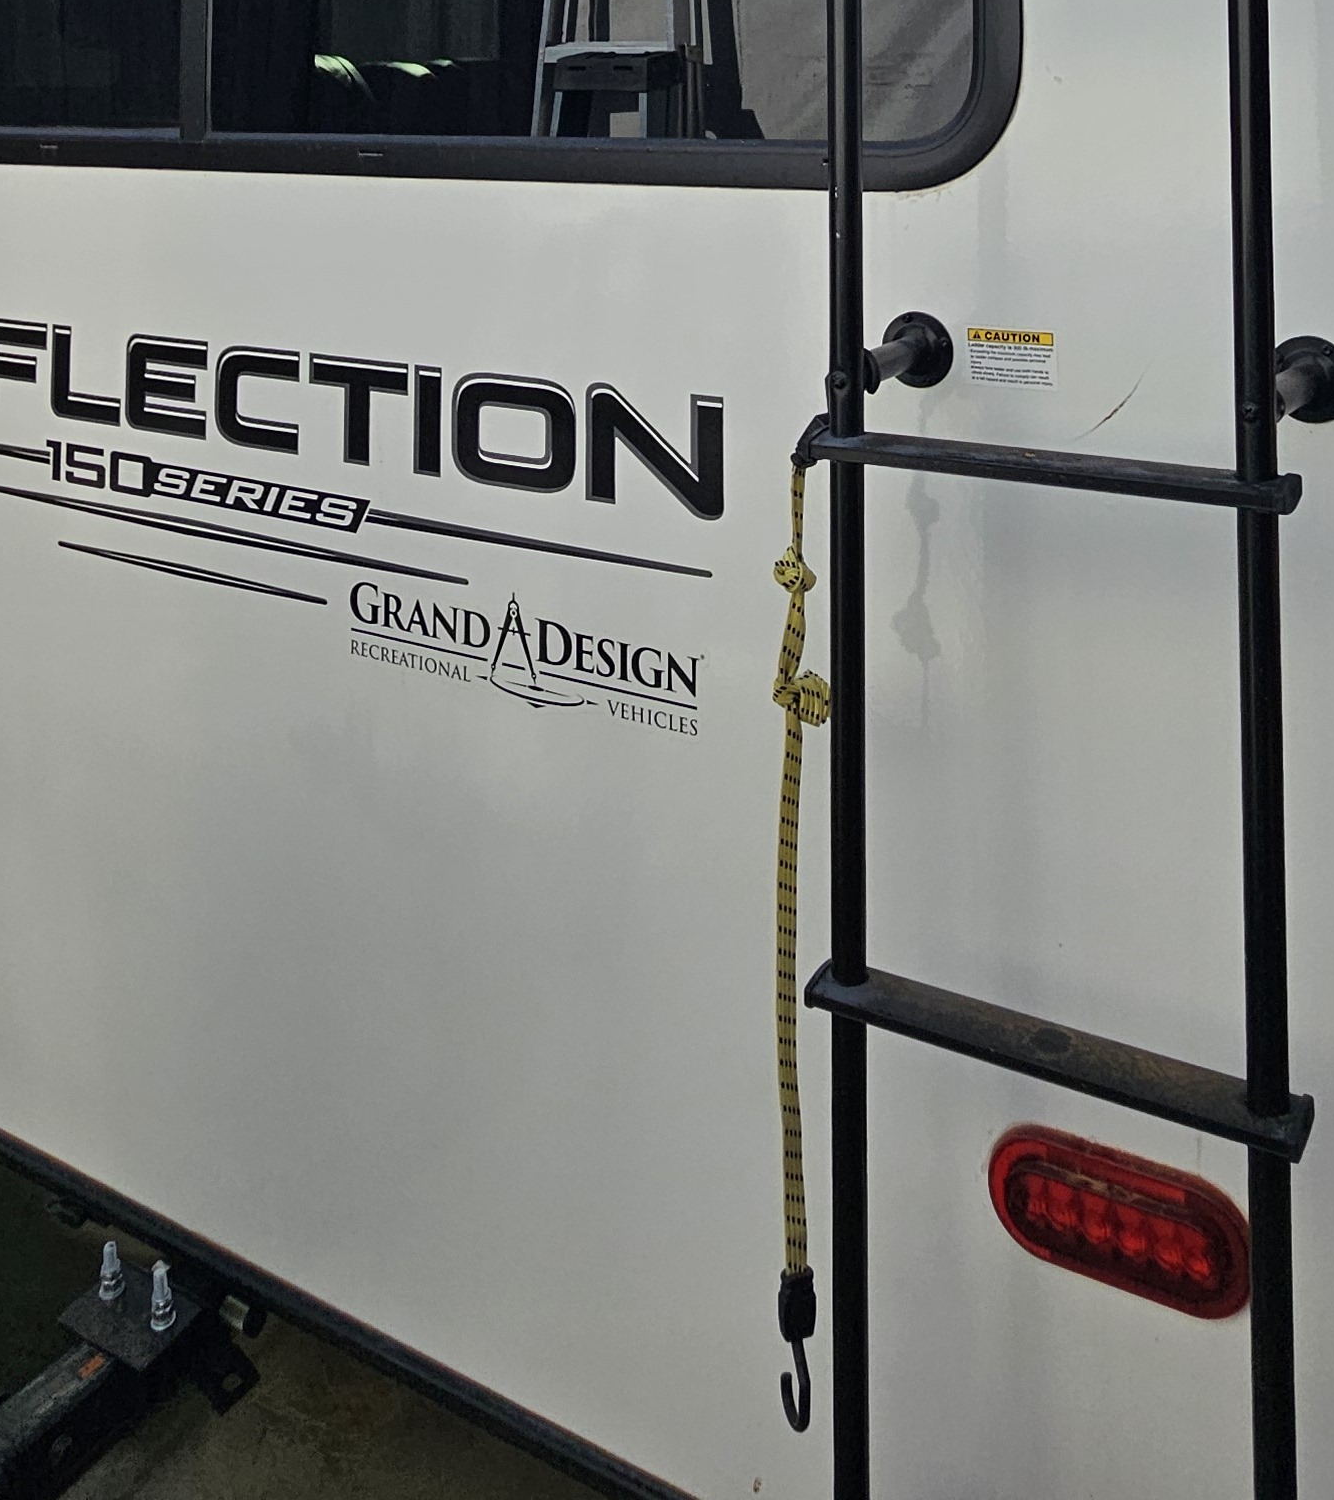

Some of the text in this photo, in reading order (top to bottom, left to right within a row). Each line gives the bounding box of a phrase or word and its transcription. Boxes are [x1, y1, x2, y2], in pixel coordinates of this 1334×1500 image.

[984, 331, 1040, 343] CAUTION
[46, 439, 358, 527] 150 SERIES
[349, 581, 701, 699] GRAND DESIGN
[350, 639, 699, 737] RECREATIONAL VEHICLES
